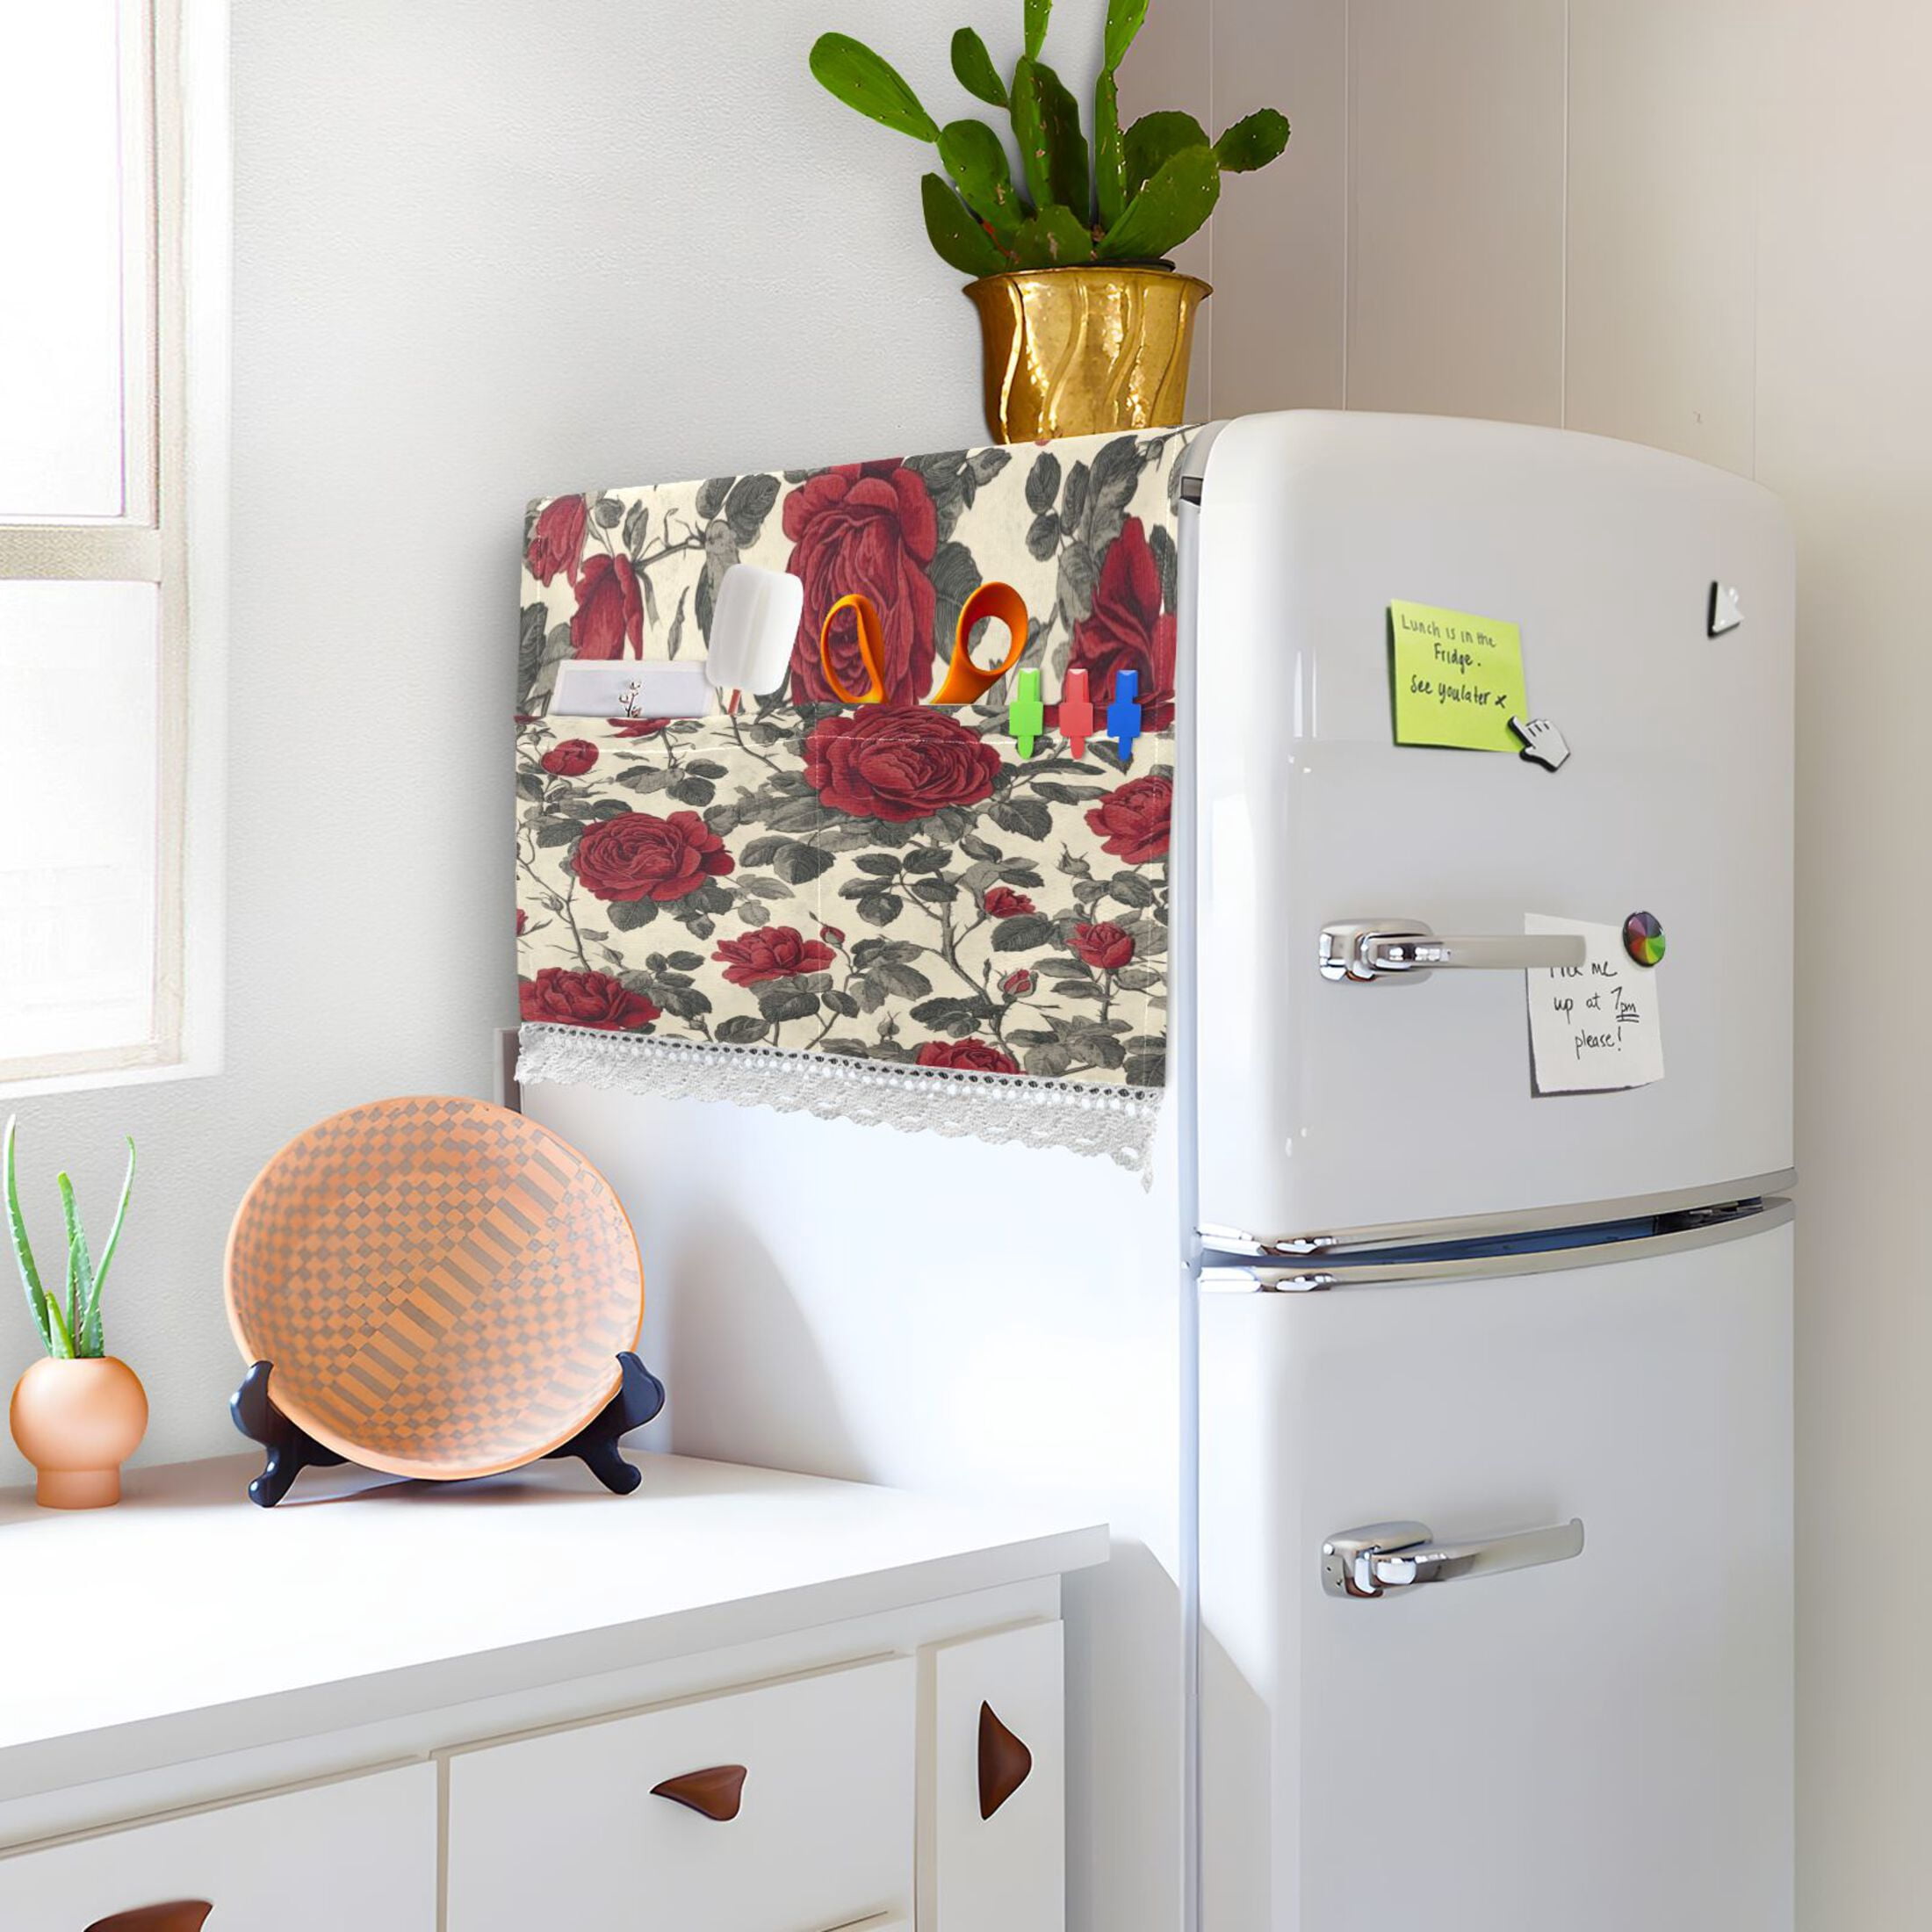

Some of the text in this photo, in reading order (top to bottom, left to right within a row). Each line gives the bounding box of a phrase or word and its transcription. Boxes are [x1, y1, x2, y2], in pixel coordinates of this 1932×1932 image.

[1402, 614, 1496, 648] Lunch is in the
[1410, 674, 1433, 695] See
[1591, 961, 1618, 977] me
[1554, 997, 1574, 1024] up
[1586, 992, 1601, 1010] at
[1575, 1026, 1621, 1060] please!
